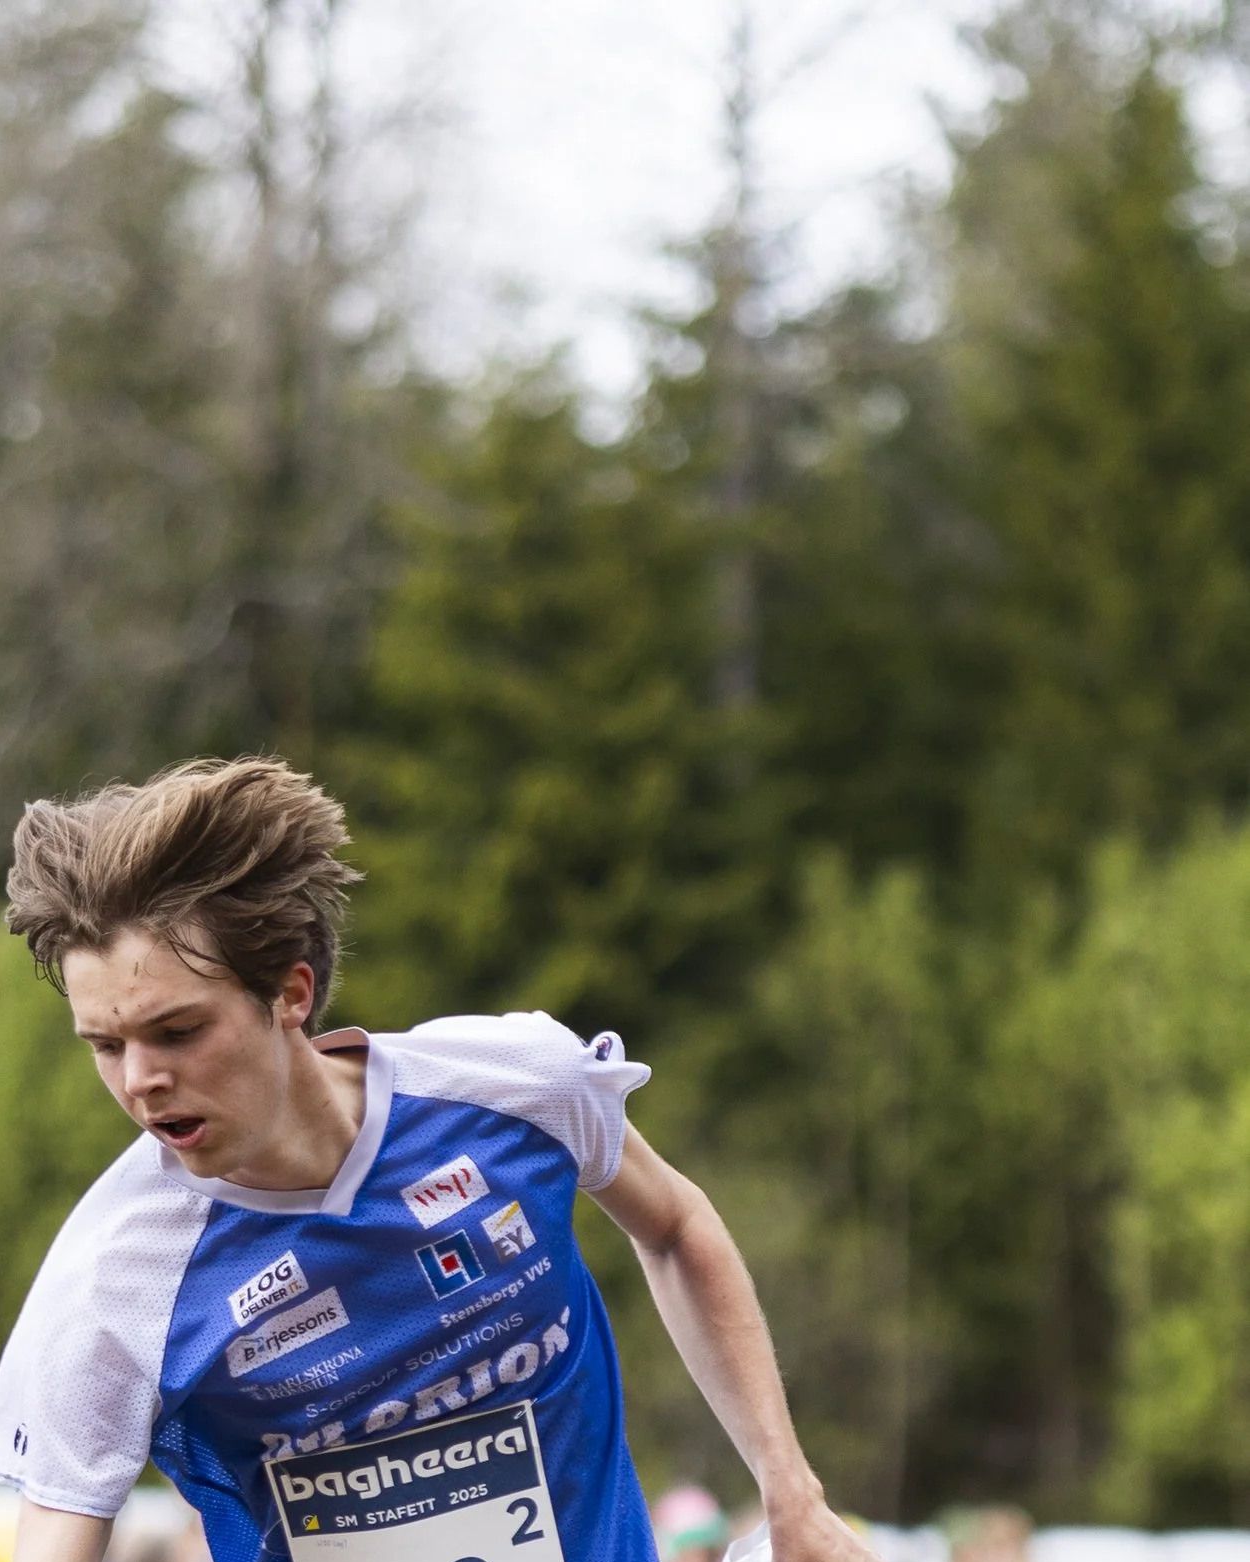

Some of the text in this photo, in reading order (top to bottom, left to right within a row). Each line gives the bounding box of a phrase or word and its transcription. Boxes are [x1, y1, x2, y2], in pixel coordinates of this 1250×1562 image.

[493, 1225, 527, 1263] EY
[241, 1287, 288, 1319] DELIVER
[440, 1256, 552, 1328] Stensborgs VVS
[263, 1346, 366, 1394] KARLSKRONA
[305, 1312, 524, 1418] S-GROUP SOLUTIONS
[280, 1426, 528, 1502] bagheera
[336, 1483, 489, 1528] SM STAFETT 2025
[505, 1497, 544, 1546] 2
